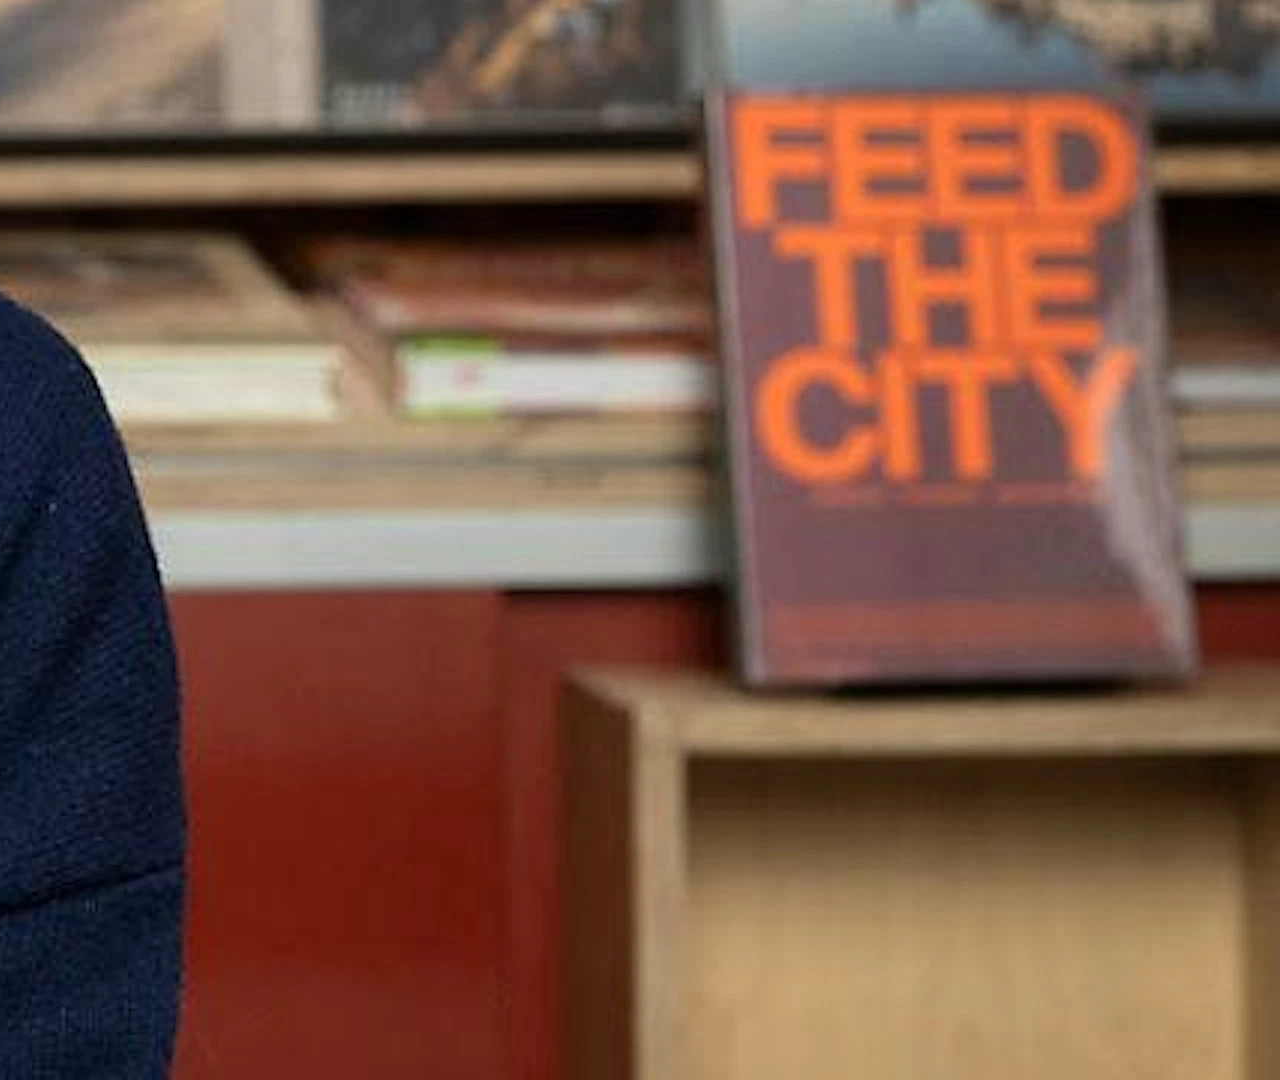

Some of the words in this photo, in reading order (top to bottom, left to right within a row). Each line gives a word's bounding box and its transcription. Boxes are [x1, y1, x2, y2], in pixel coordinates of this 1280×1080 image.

[730, 92, 1138, 231] FEED
[772, 223, 1102, 354] THE
[754, 344, 1138, 484] CITY
